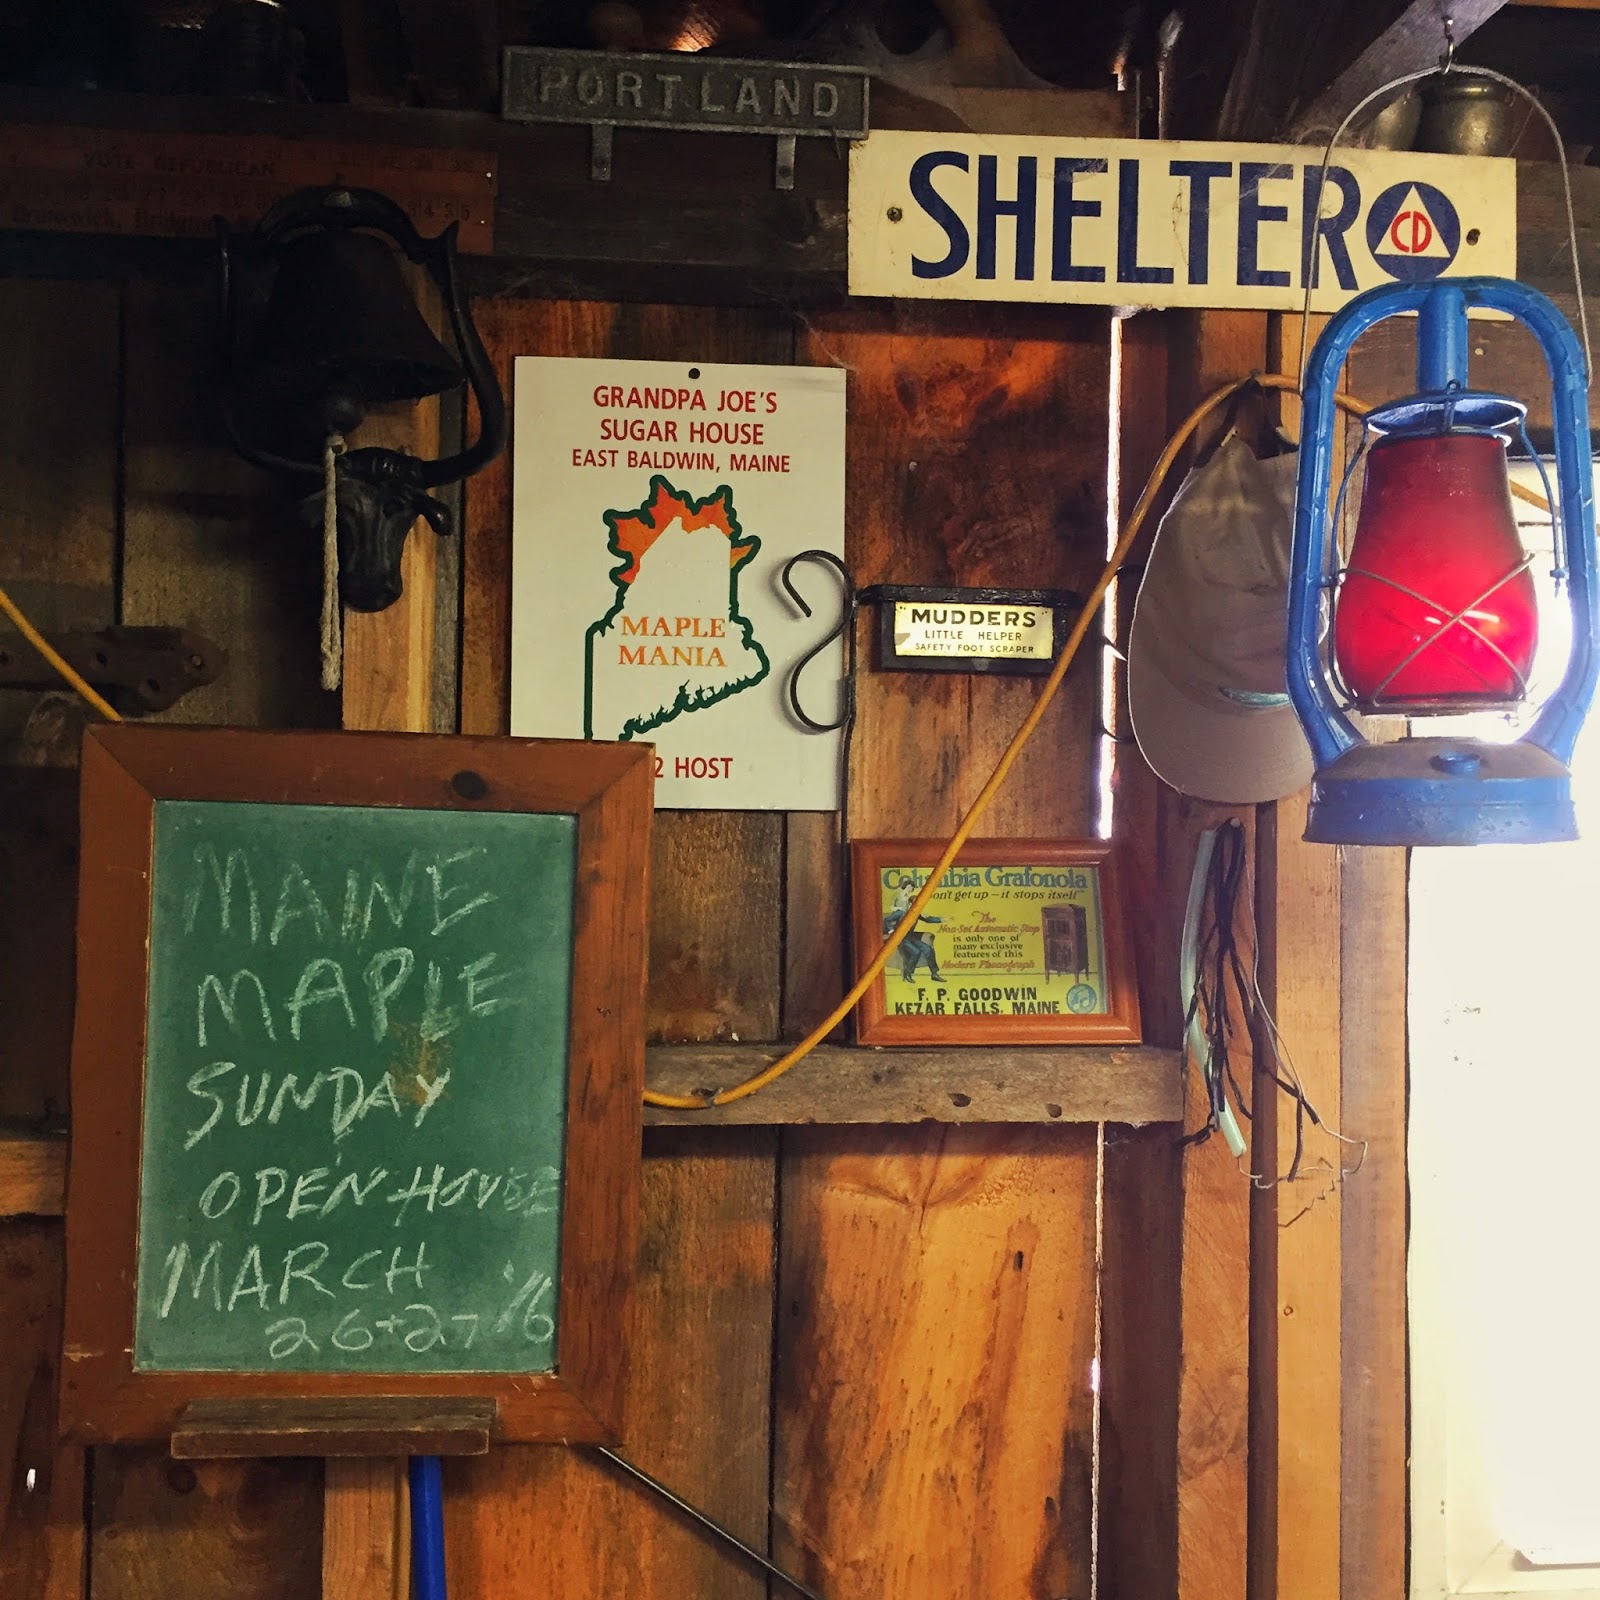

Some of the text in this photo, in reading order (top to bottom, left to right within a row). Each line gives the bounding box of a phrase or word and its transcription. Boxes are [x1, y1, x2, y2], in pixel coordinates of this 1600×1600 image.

[537, 64, 839, 119] PORTLAND
[908, 149, 1361, 291] SHELTER
[1390, 210, 1431, 254] CD
[593, 385, 778, 414] GRANDPA JOE'S
[600, 418, 764, 445] SUGAR HOUSE
[572, 449, 790, 473] EAST BALDWIN, MAINE
[621, 615, 726, 639] MAPLE
[911, 608, 1036, 628] MUDDERS
[924, 629, 1022, 641] LITTLE HELPER
[618, 644, 727, 667] MANIA
[915, 642, 1034, 654] SAFETY FOOT SCRAPER
[675, 757, 733, 779] HOST
[985, 865, 1088, 888] Grafonola
[183, 839, 499, 946] MAINE
[930, 890, 951, 900] on't
[954, 890, 972, 902] get
[974, 891, 989, 901] up
[1001, 889, 1010, 899] it
[1013, 890, 1044, 901] stops
[971, 910, 996, 923] The
[965, 934, 984, 943] only
[1010, 934, 1019, 942] of
[973, 924, 1019, 933] Automatic
[953, 941, 1023, 951] many exclusive
[953, 949, 1023, 958] features of this
[941, 960, 1035, 973] Modern Phonograph
[197, 946, 517, 1048] MAPLE
[918, 987, 1037, 1001] F. P. GOODWIN
[895, 1001, 945, 1015] KEZAR
[1012, 1001, 1060, 1015] MAINE
[184, 1060, 452, 1151] SUNDAY
[199, 1165, 390, 1226] OPEN
[158, 1240, 434, 1319] MARCH
